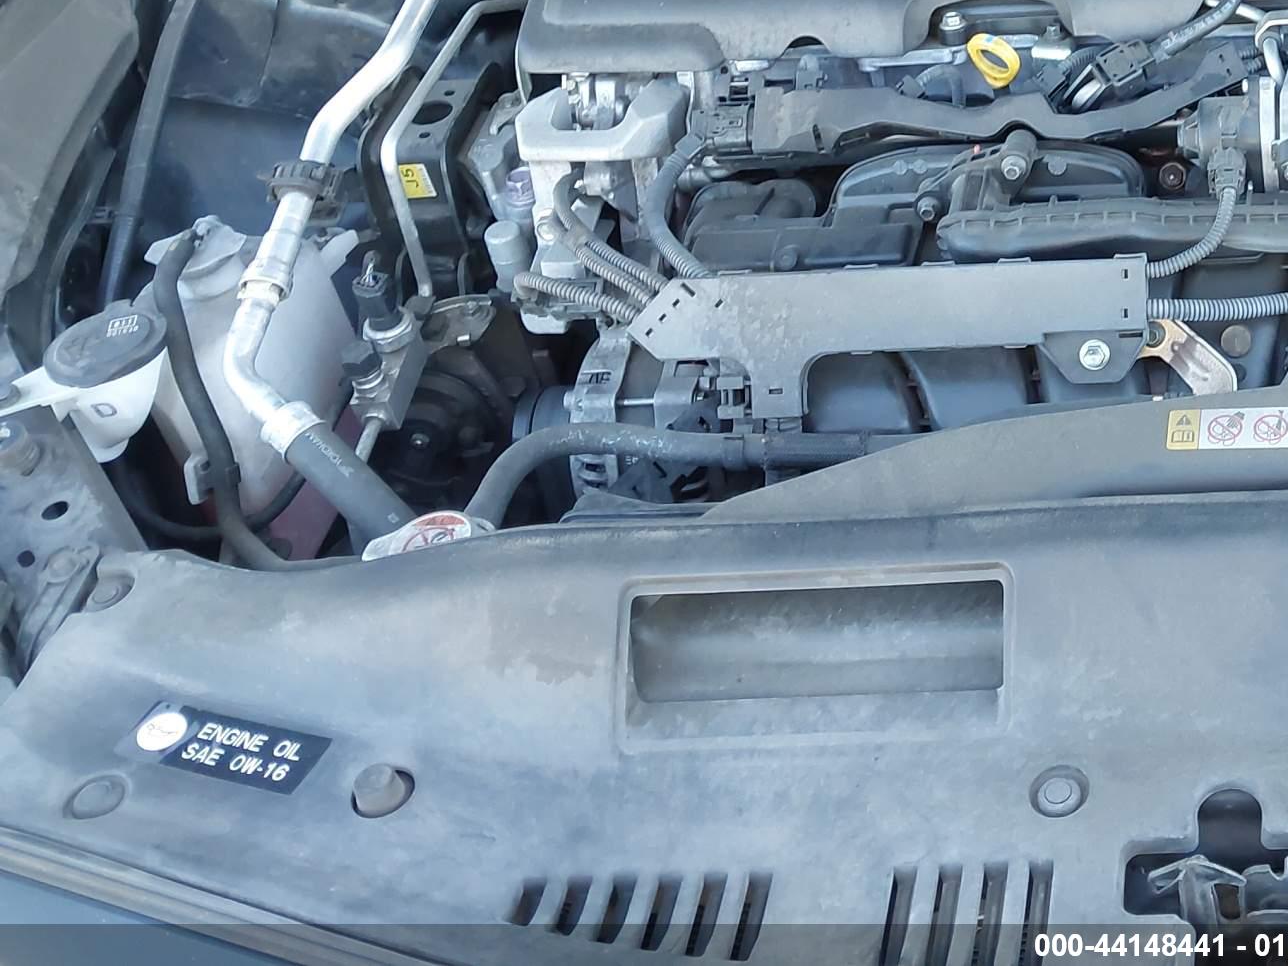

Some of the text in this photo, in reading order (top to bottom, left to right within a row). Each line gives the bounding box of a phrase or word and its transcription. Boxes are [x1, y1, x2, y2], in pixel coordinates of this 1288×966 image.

[400, 167, 420, 189] J5
[181, 742, 290, 782] SAE 0W-16
[197, 722, 302, 762] ENGINE OIL
